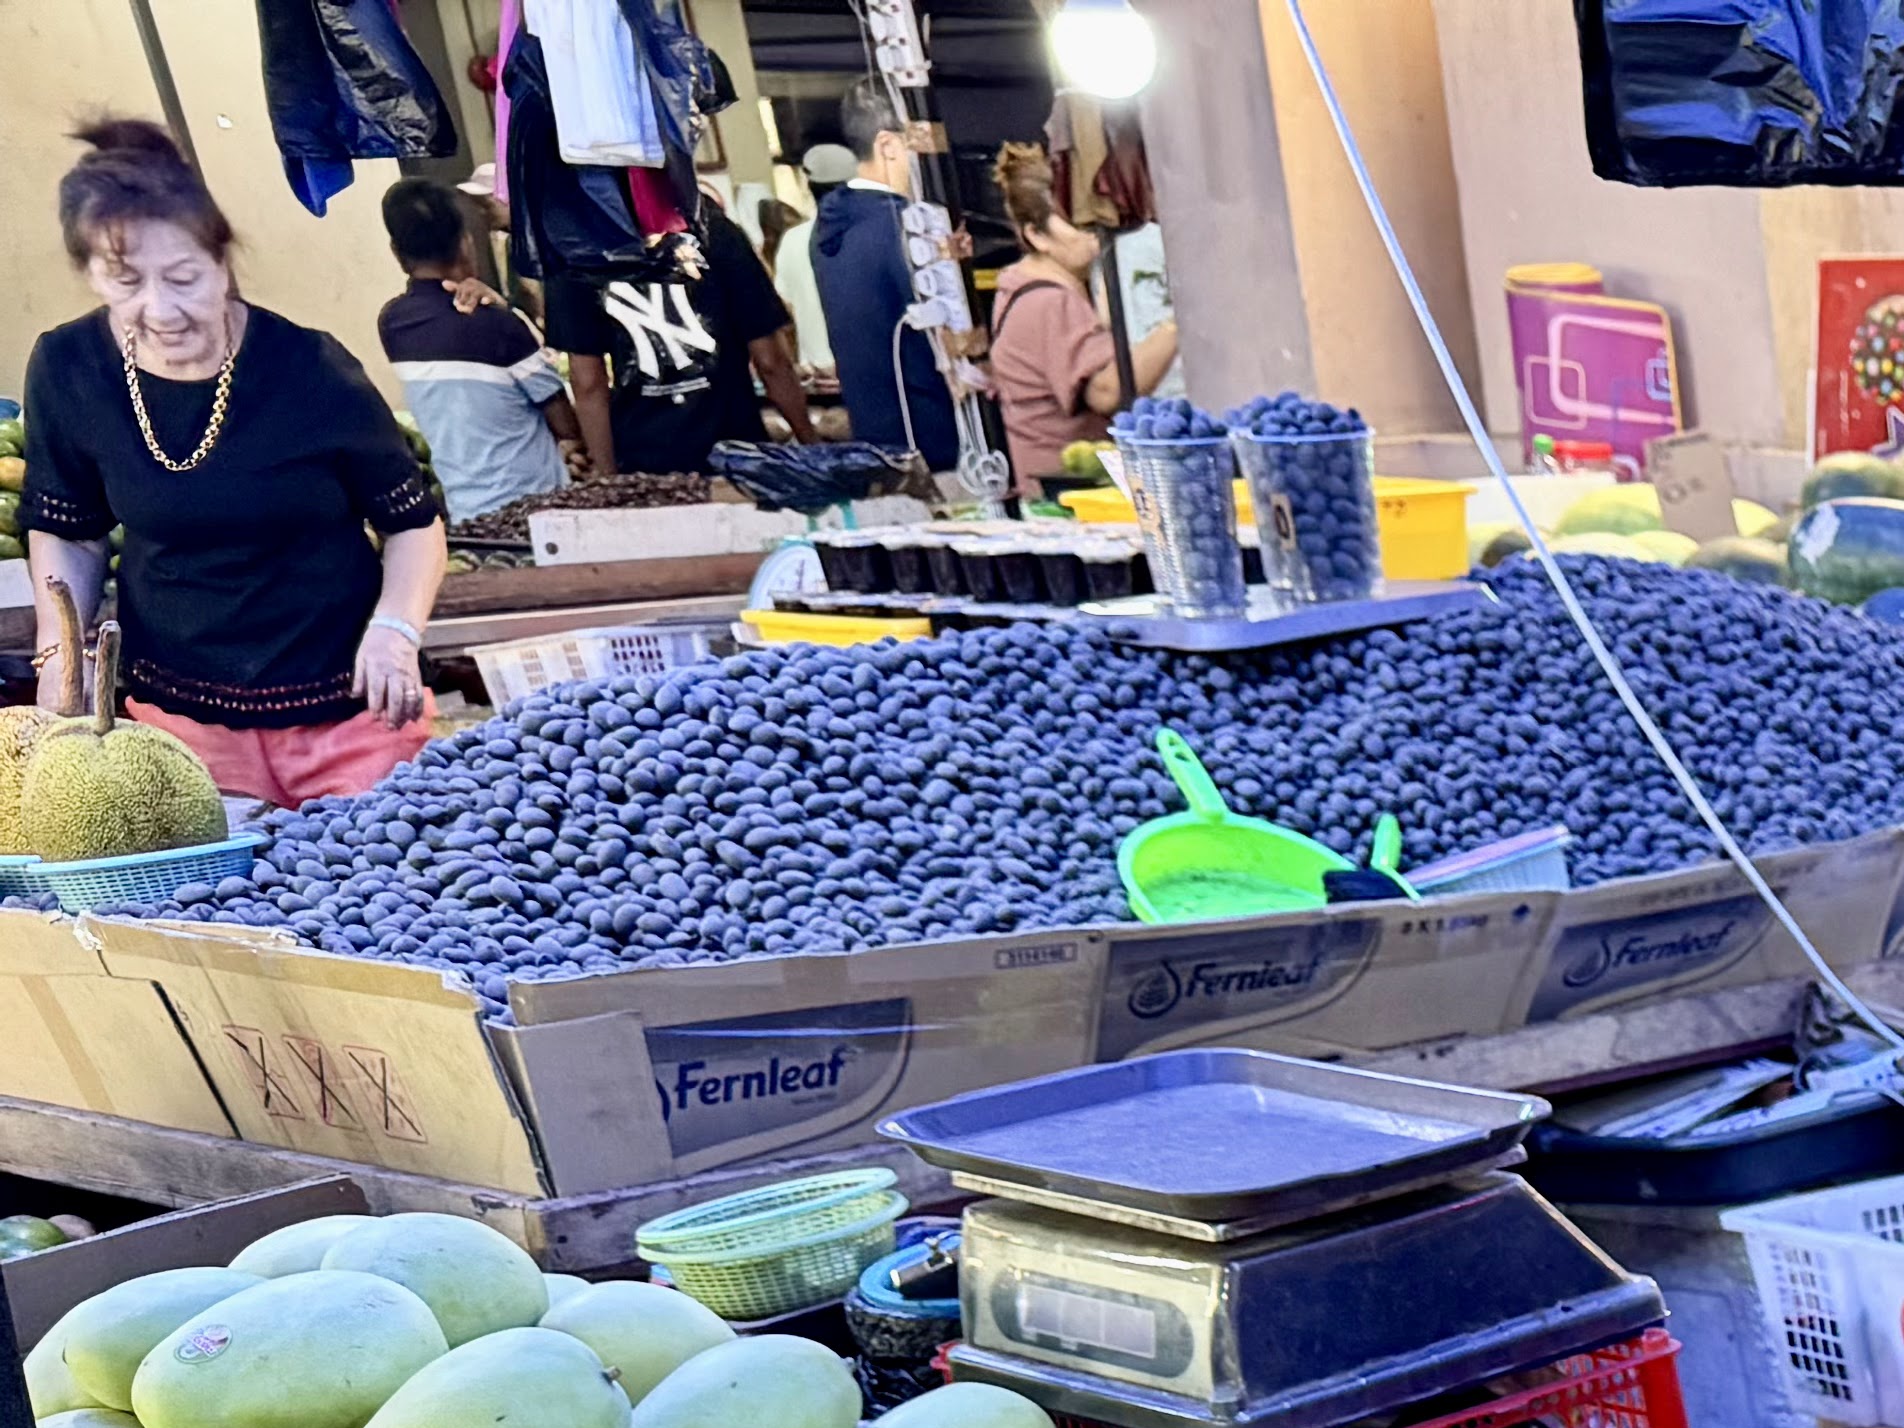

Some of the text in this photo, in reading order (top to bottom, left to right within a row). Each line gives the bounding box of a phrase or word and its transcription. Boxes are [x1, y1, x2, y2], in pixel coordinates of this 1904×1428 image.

[1612, 921, 1736, 964] Fernleaf
[1186, 952, 1321, 999] Fernleaf
[674, 1045, 848, 1110] Fernleaf
